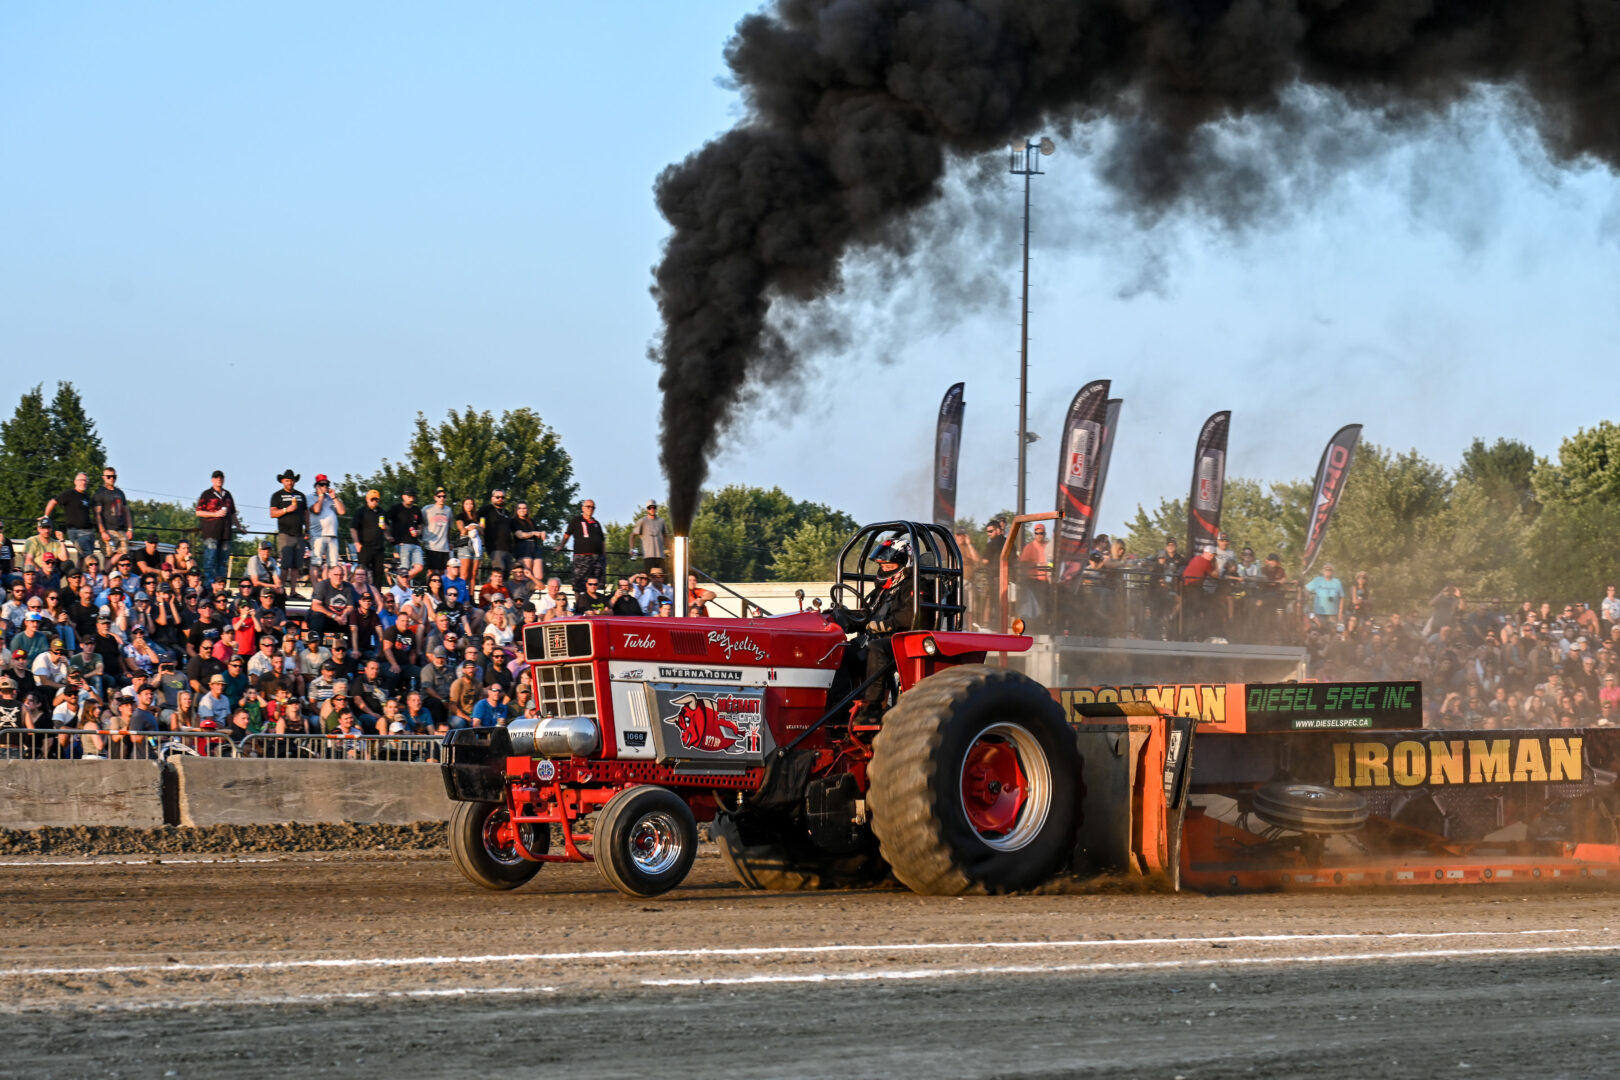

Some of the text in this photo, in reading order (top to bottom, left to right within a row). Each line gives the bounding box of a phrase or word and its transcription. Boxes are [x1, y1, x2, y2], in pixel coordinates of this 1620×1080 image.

[623, 633, 656, 649] Turbo
[707, 628, 766, 660] Red Feeling
[661, 669, 741, 680] INTERNATIONAL
[1247, 686, 1416, 712] DIESEL SPEC INC
[1295, 718, 1369, 728] WWW.DIESELSPEC.CA
[1333, 737, 1583, 787] IRONMAN
